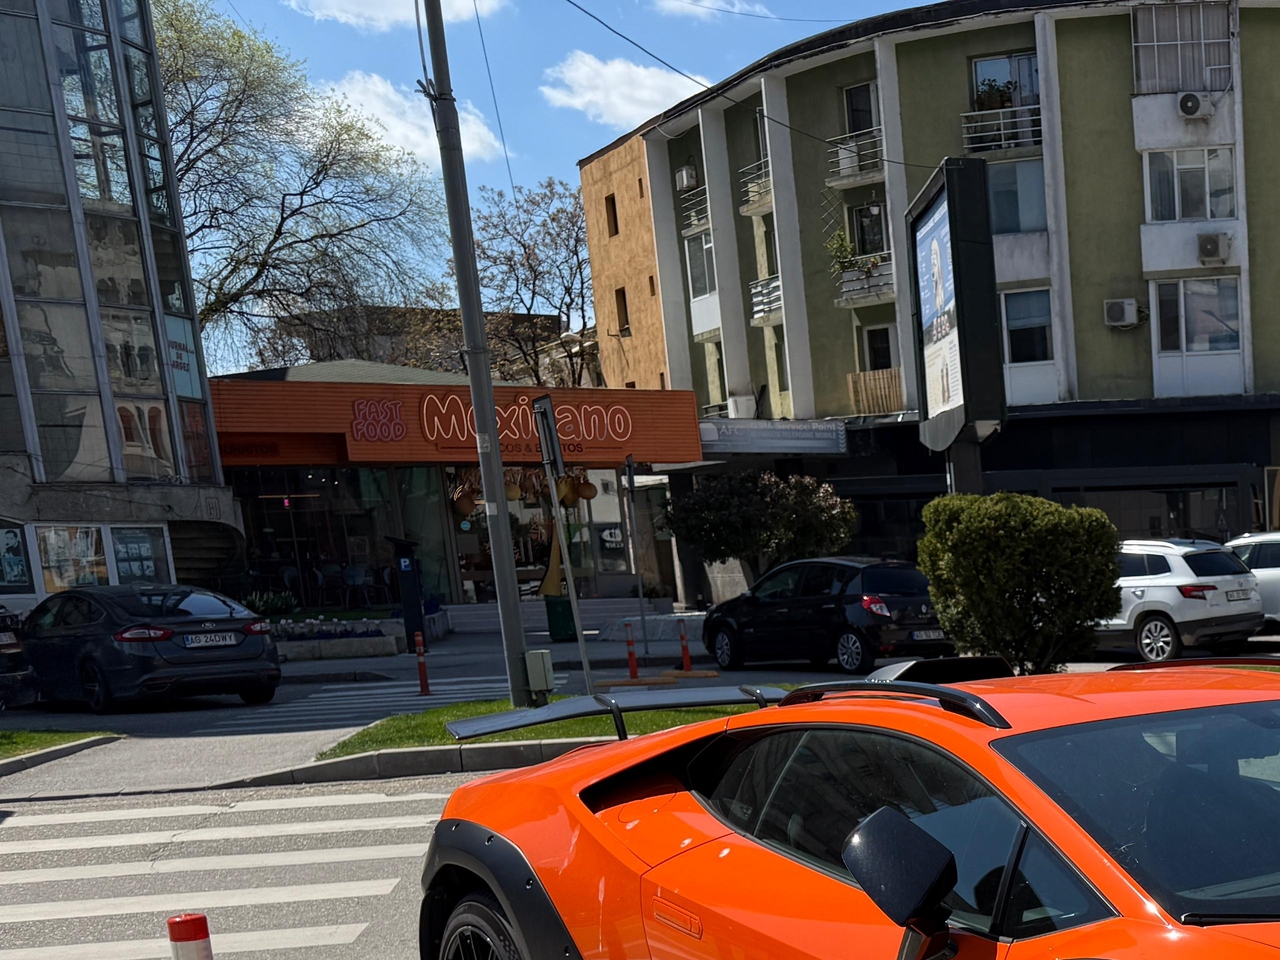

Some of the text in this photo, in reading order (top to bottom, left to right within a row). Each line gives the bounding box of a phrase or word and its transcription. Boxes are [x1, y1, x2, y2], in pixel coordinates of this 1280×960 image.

[354, 399, 402, 421] FAST
[423, 394, 633, 442] Mxiano
[352, 420, 406, 441] FOOD
[776, 422, 810, 431] Service
[811, 422, 836, 431] Point
